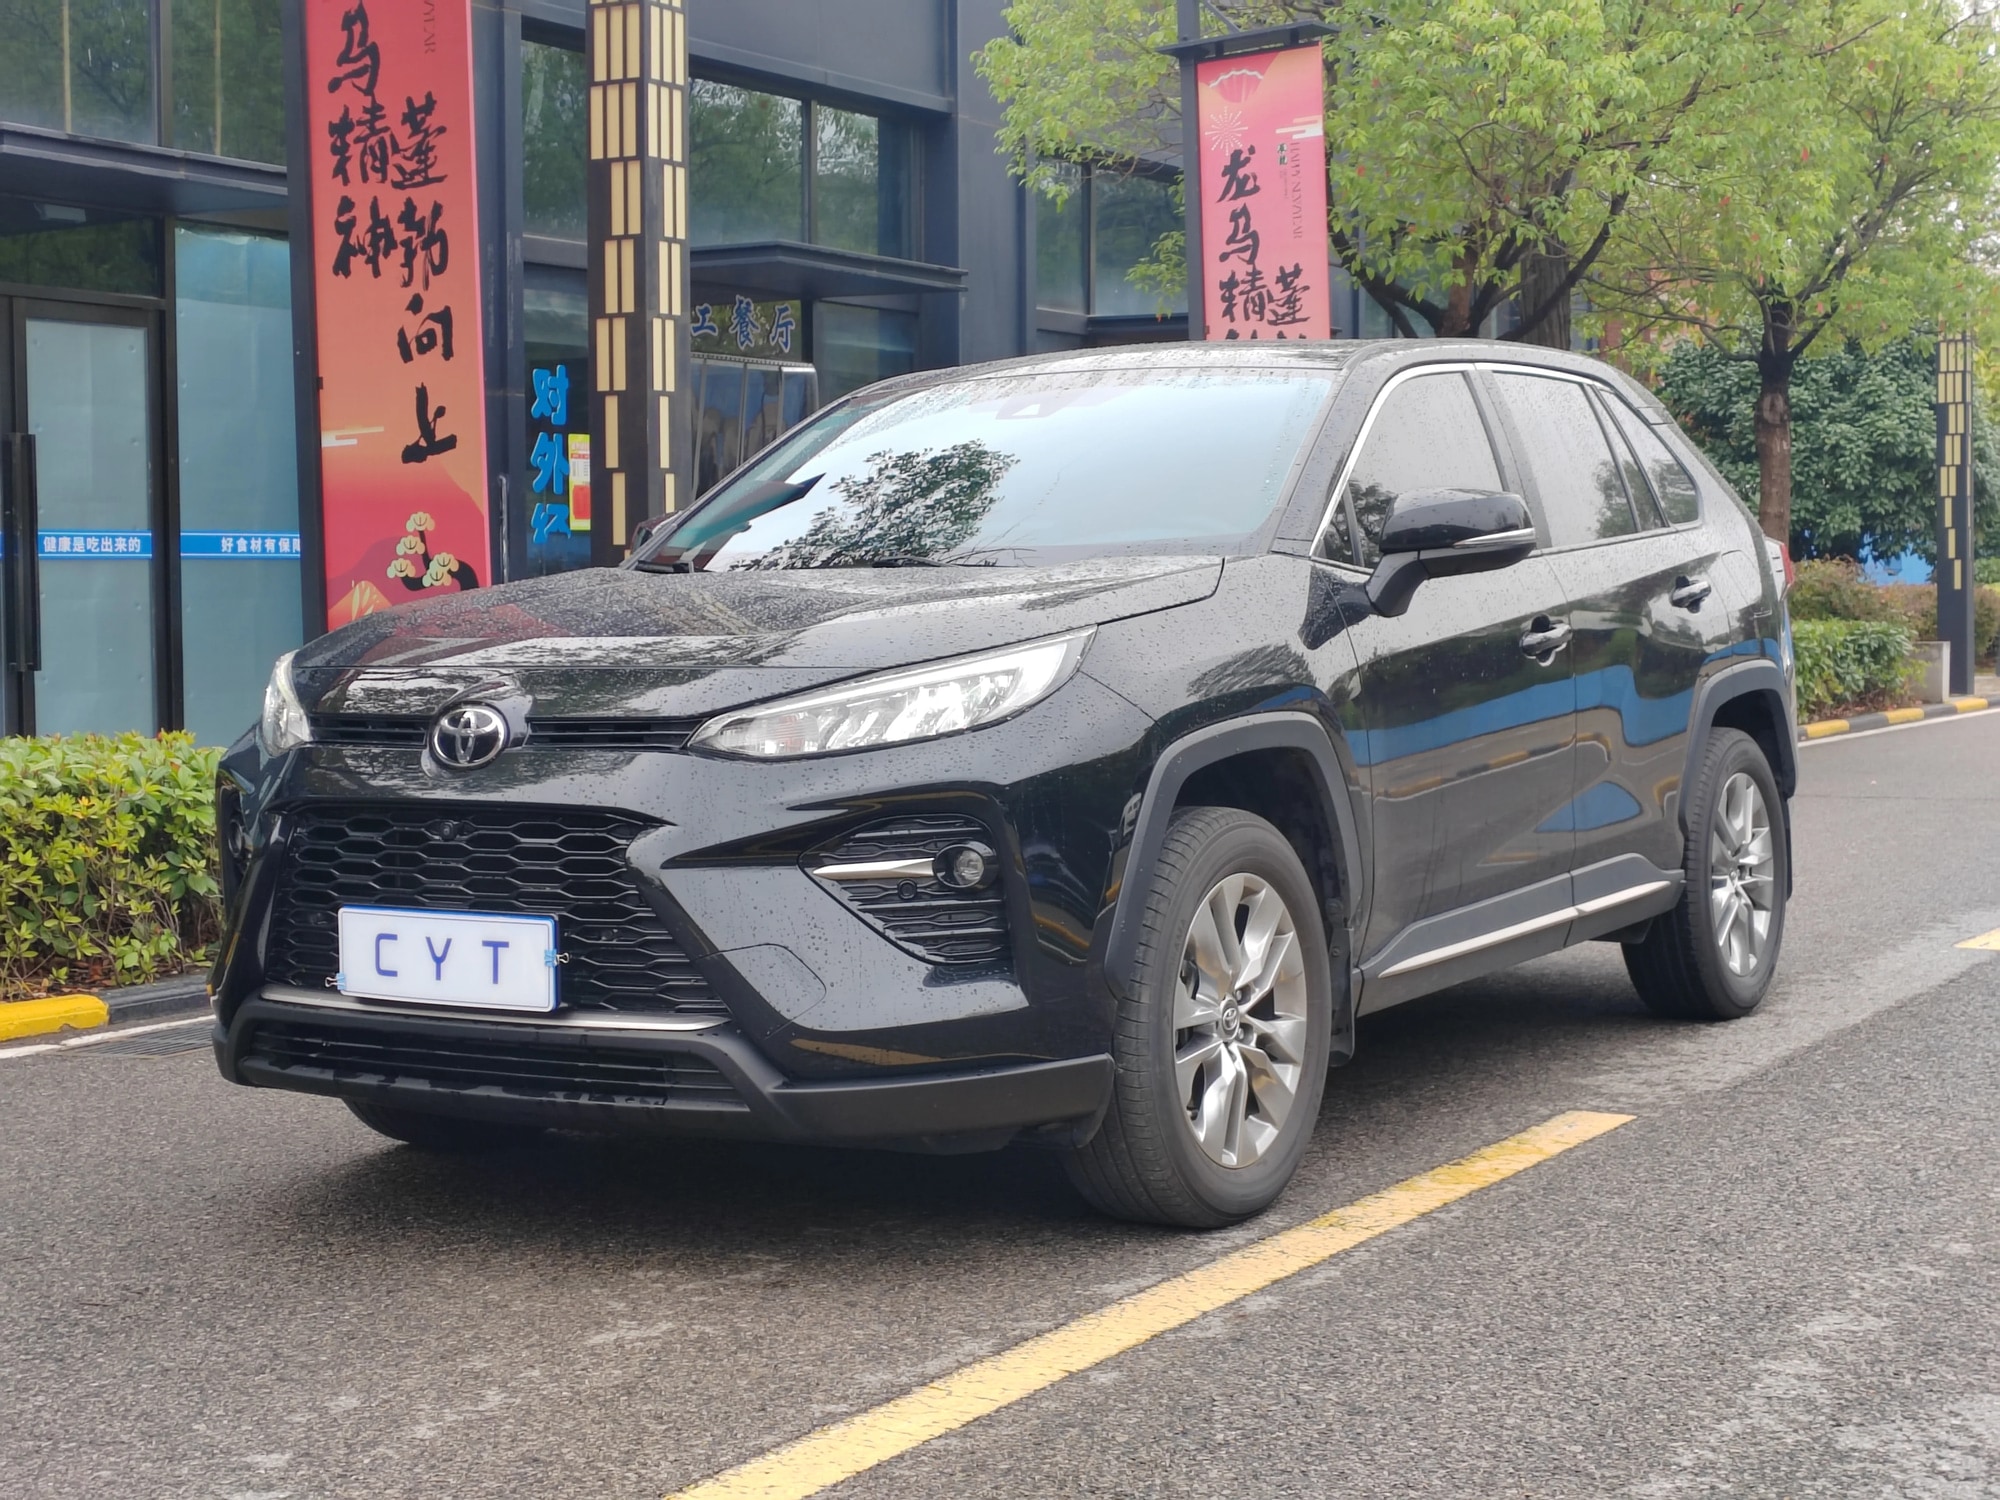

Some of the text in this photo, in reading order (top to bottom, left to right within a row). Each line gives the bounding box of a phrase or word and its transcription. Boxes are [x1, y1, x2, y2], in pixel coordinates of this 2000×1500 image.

[1216, 145, 1267, 340] 龙马精
[43, 536, 141, 553] 健康是吃出来的
